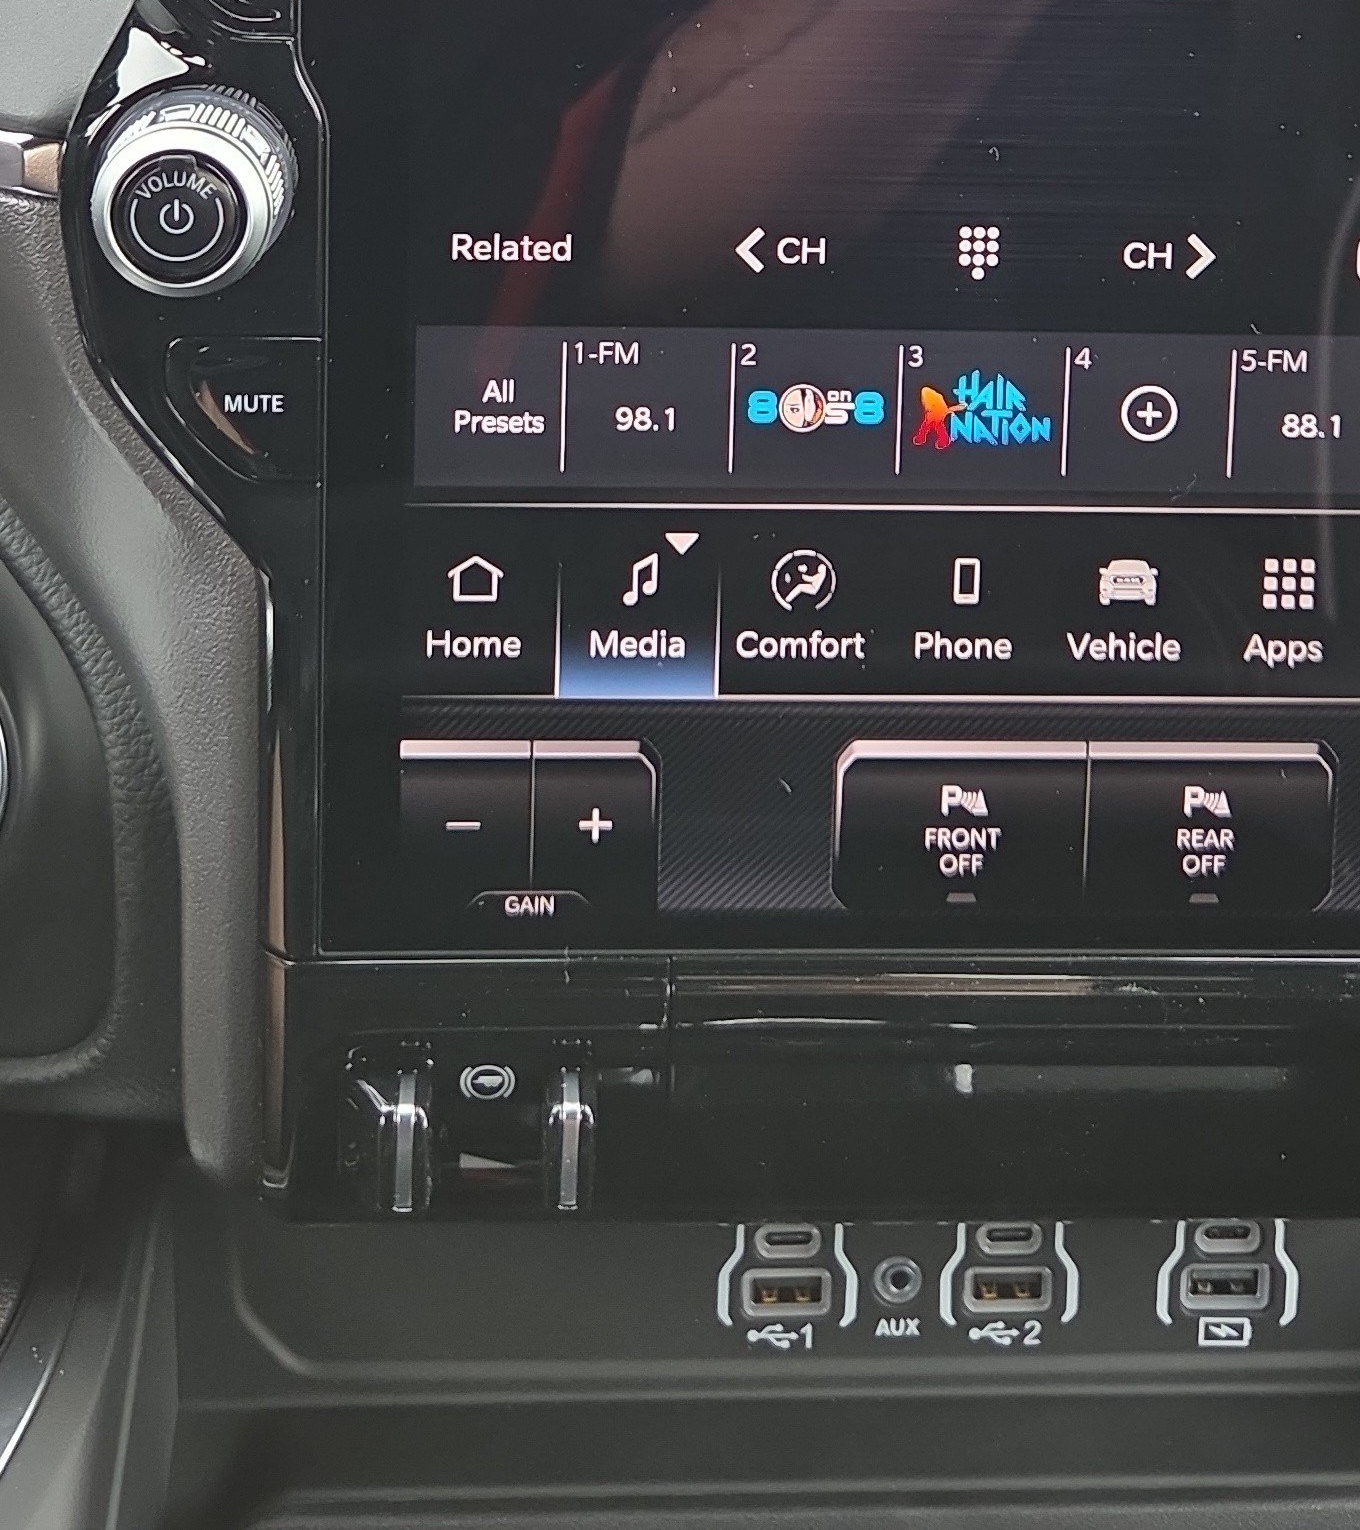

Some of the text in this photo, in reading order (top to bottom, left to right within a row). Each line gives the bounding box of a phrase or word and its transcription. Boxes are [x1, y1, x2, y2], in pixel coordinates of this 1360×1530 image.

[135, 170, 217, 200] VOLUME
[451, 234, 573, 262] Related
[776, 237, 827, 266] CH
[1123, 242, 1173, 269] CH
[574, 342, 640, 366] 1-FM
[740, 343, 758, 367] 2
[907, 345, 925, 369] 3
[1073, 347, 1093, 370] 4
[1240, 349, 1309, 373] 5-FM
[481, 379, 516, 404] All
[952, 370, 1028, 411] HAIR
[224, 394, 285, 413] MUTE
[453, 410, 545, 436] Presets
[615, 408, 676, 433] 98.1
[1281, 414, 1342, 439] 88.1
[426, 629, 522, 660] Home
[589, 629, 686, 660] Media
[736, 630, 866, 660] Comfort
[914, 631, 1013, 661] Phone
[1066, 632, 1182, 662] Vehicle
[1243, 633, 1324, 668] Apps
[925, 828, 1002, 851] FRONT
[1176, 828, 1235, 851] REAR
[939, 854, 984, 877] OFF
[1182, 854, 1226, 877] OFF
[504, 895, 555, 917] GAIN
[800, 1323, 813, 1348] 1
[875, 1318, 920, 1336] AUX
[1024, 1320, 1042, 1344] 2
